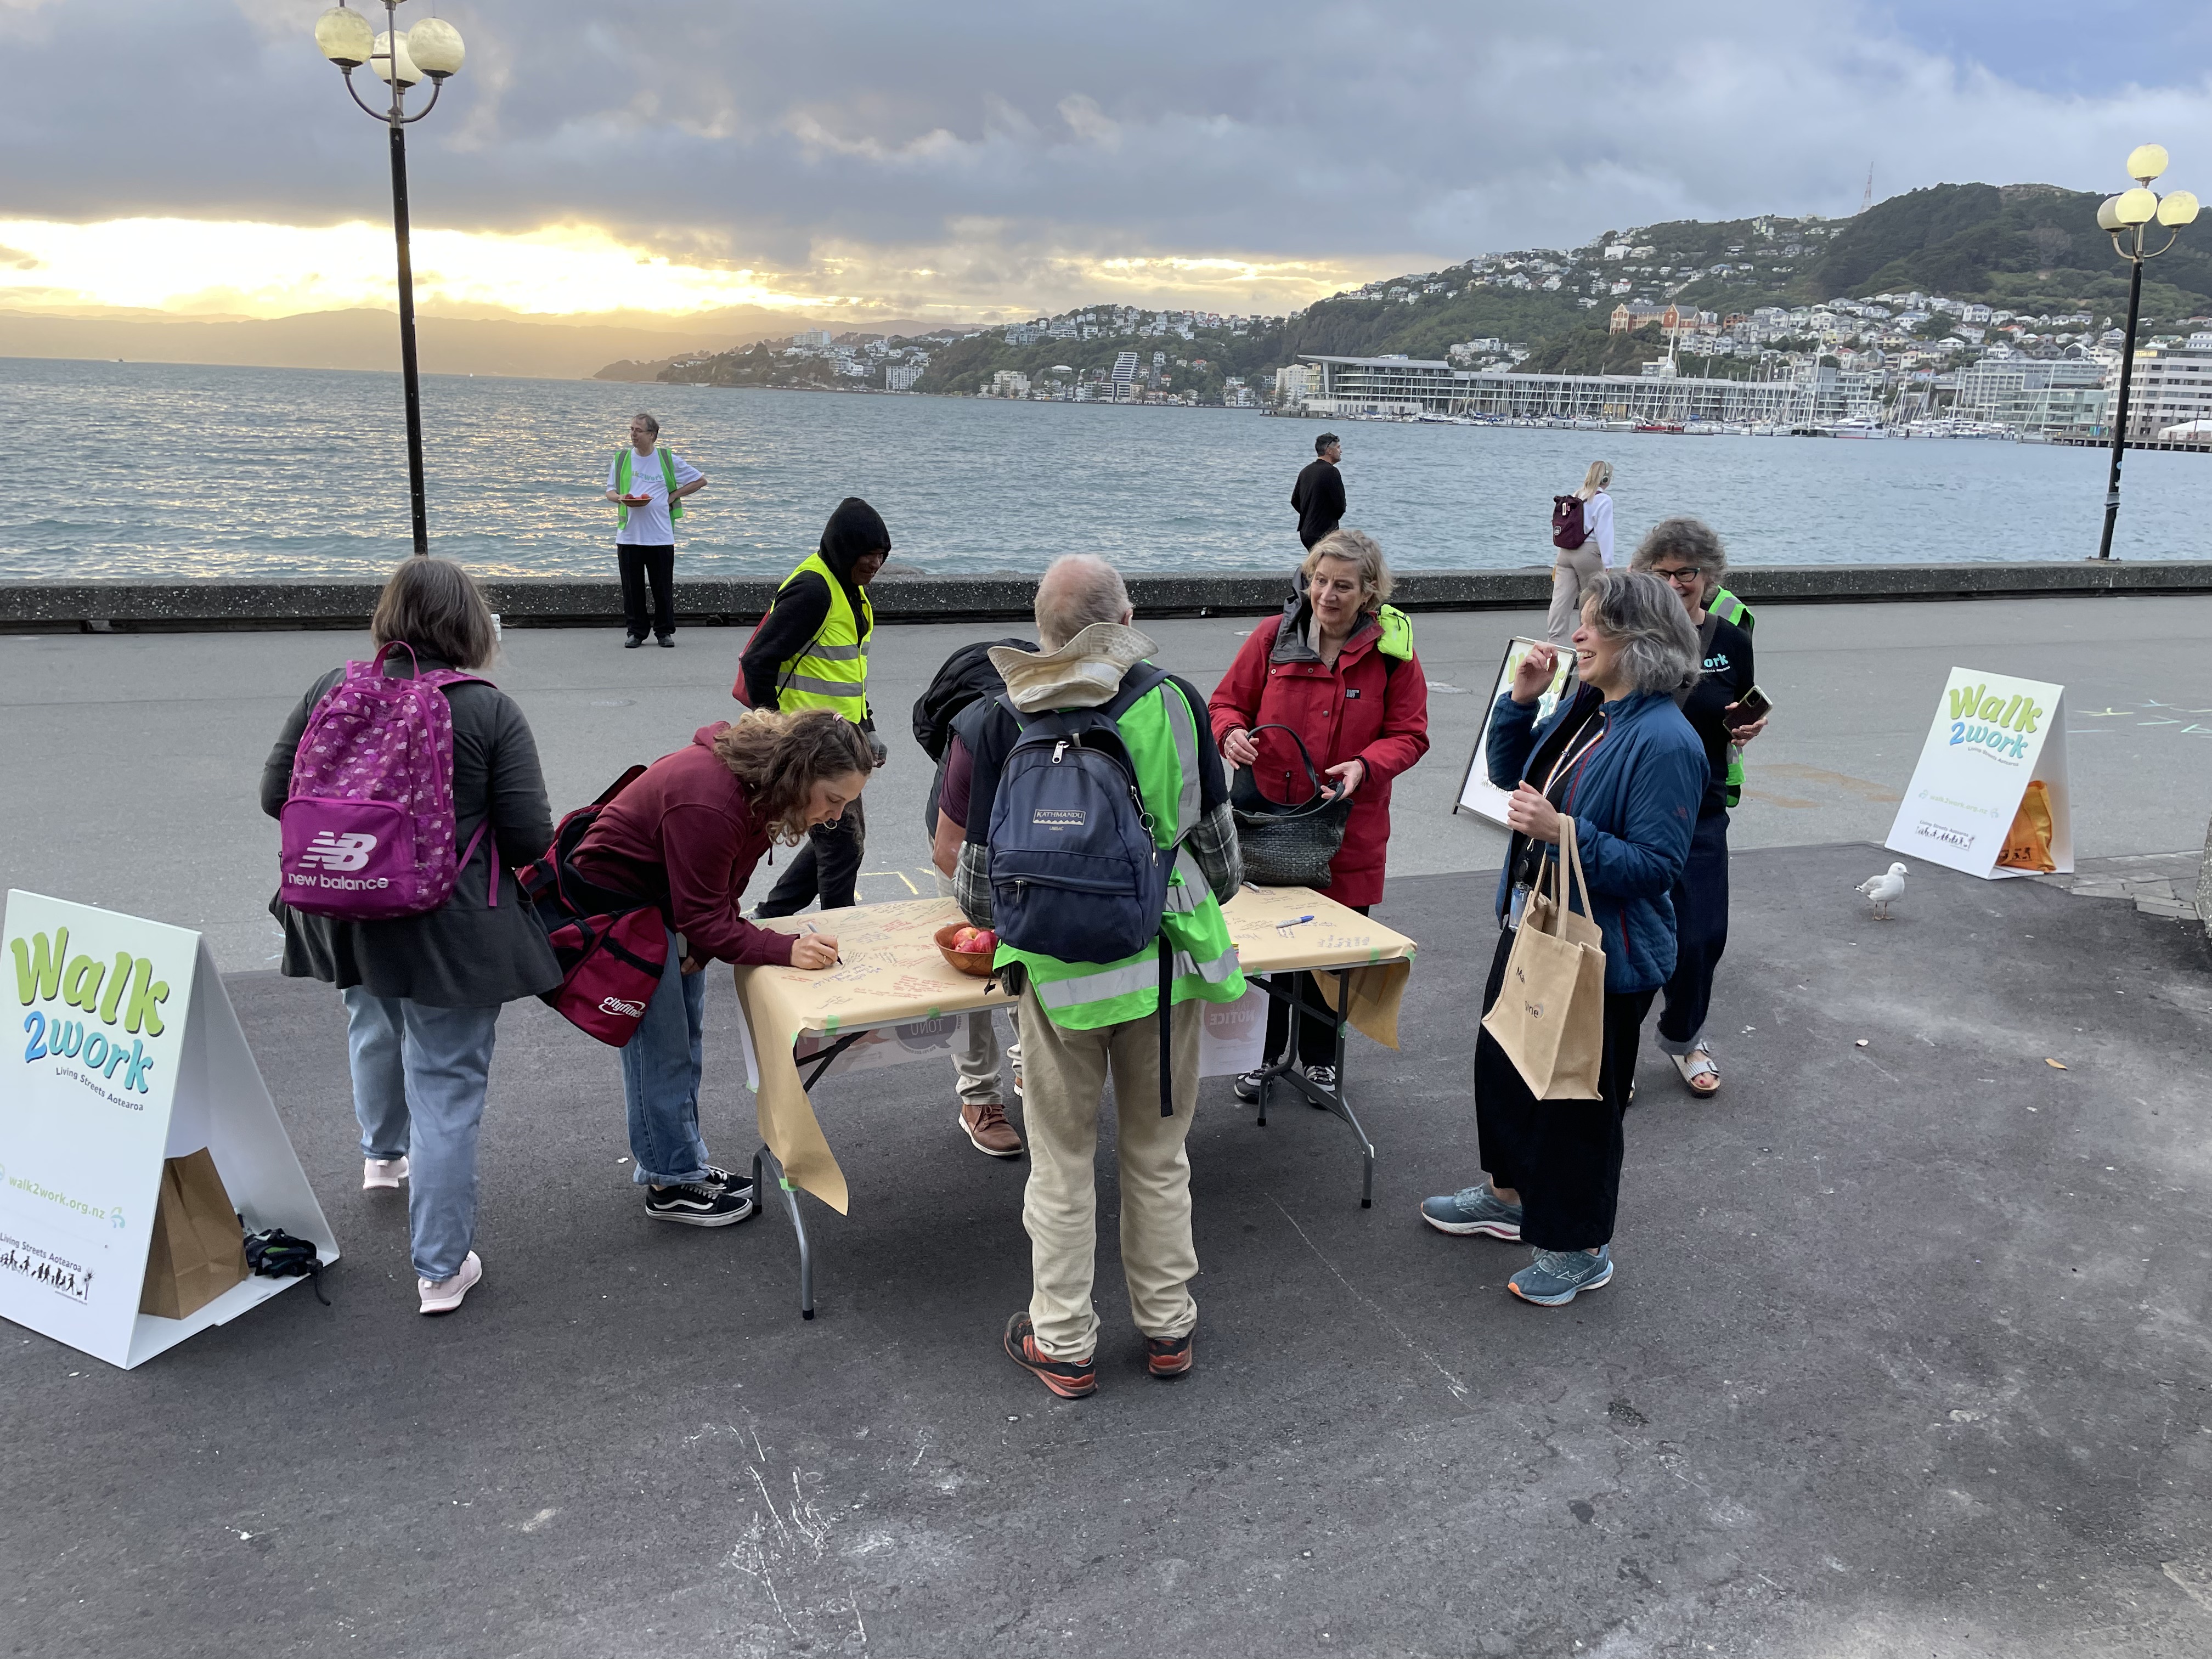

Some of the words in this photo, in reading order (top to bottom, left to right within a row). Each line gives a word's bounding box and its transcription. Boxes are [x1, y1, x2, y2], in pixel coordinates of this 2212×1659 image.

[632, 471, 663, 481] lk2Work
[1703, 653, 1729, 667] ork
[1949, 684, 2042, 733] Walk
[1949, 722, 2028, 759] 2work
[1930, 795, 1988, 814] walk2work.org.nz
[287, 873, 317, 887] new
[320, 874, 390, 890] balance
[10, 926, 170, 1037] Walk
[24, 1011, 154, 1094] 2work
[56, 1067, 78, 1080] Living
[80, 1074, 105, 1097] Streets
[107, 1093, 143, 1111] Aotearoa
[9, 1176, 105, 1219] walk2work.org.nz
[0, 1232, 19, 1249] Living
[21, 1241, 47, 1259] Streets
[48, 1252, 82, 1272] Aotearoa
